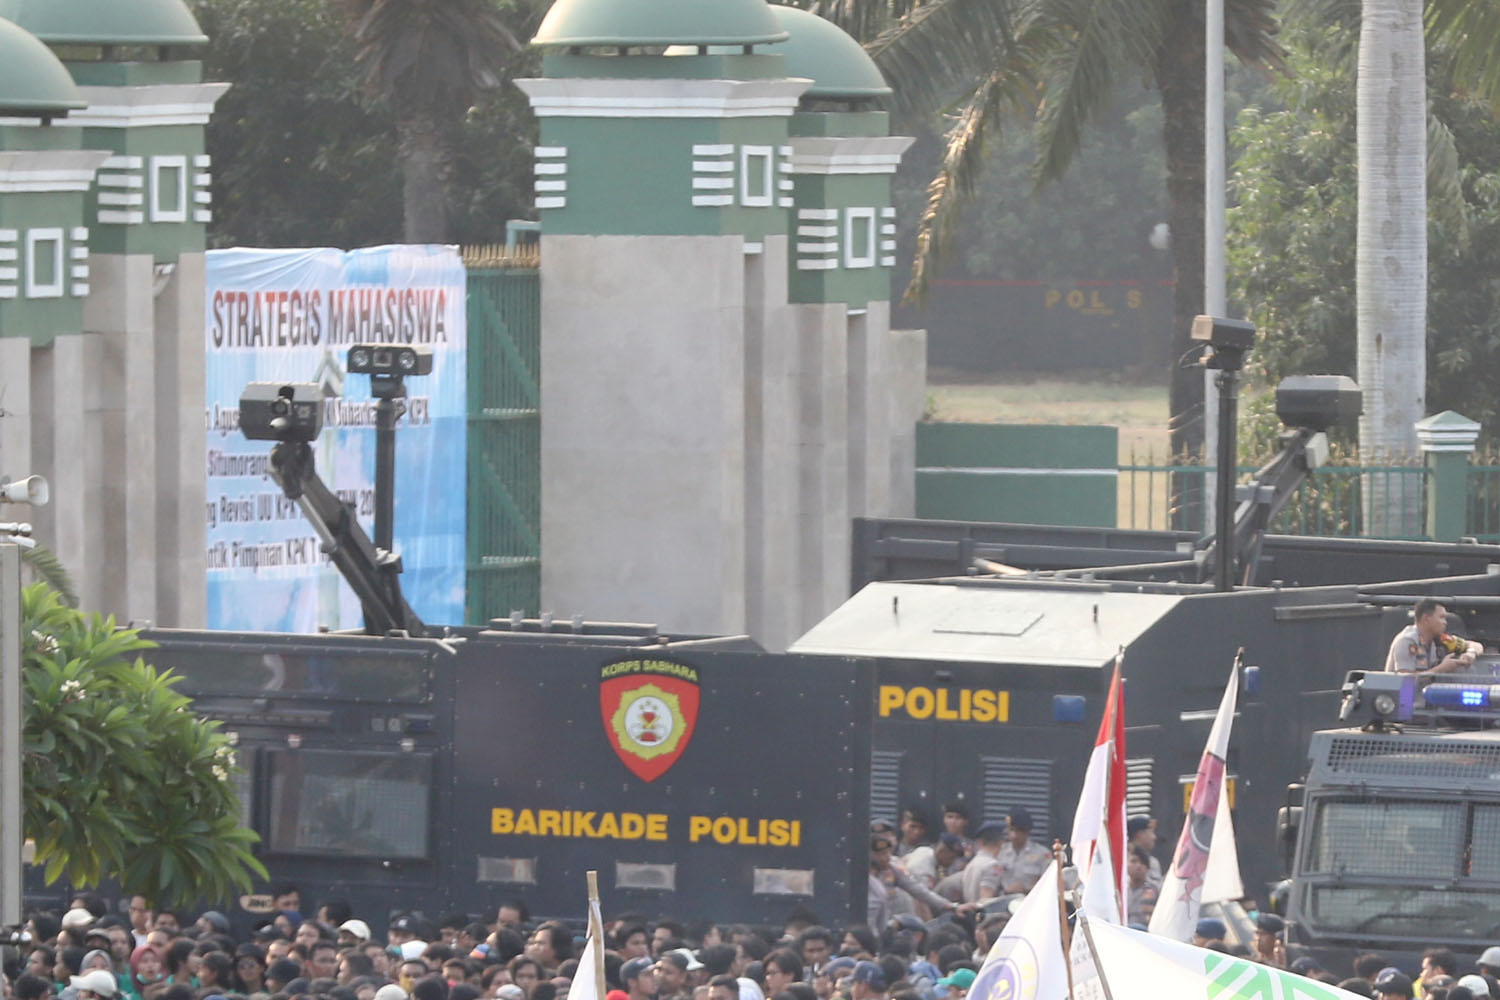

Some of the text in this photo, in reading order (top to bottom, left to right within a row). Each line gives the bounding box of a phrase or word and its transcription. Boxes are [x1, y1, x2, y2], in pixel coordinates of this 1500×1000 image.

[213, 288, 448, 348] STRATEGIS MAHASISWA
[208, 450, 268, 481] Situmorang
[220, 495, 254, 523] Revisi
[231, 541, 282, 572] Pimpinan
[601, 659, 699, 682] KORPS SABHARA
[878, 685, 1010, 723] POLISI
[490, 808, 801, 848] BARIKADE POLISI
